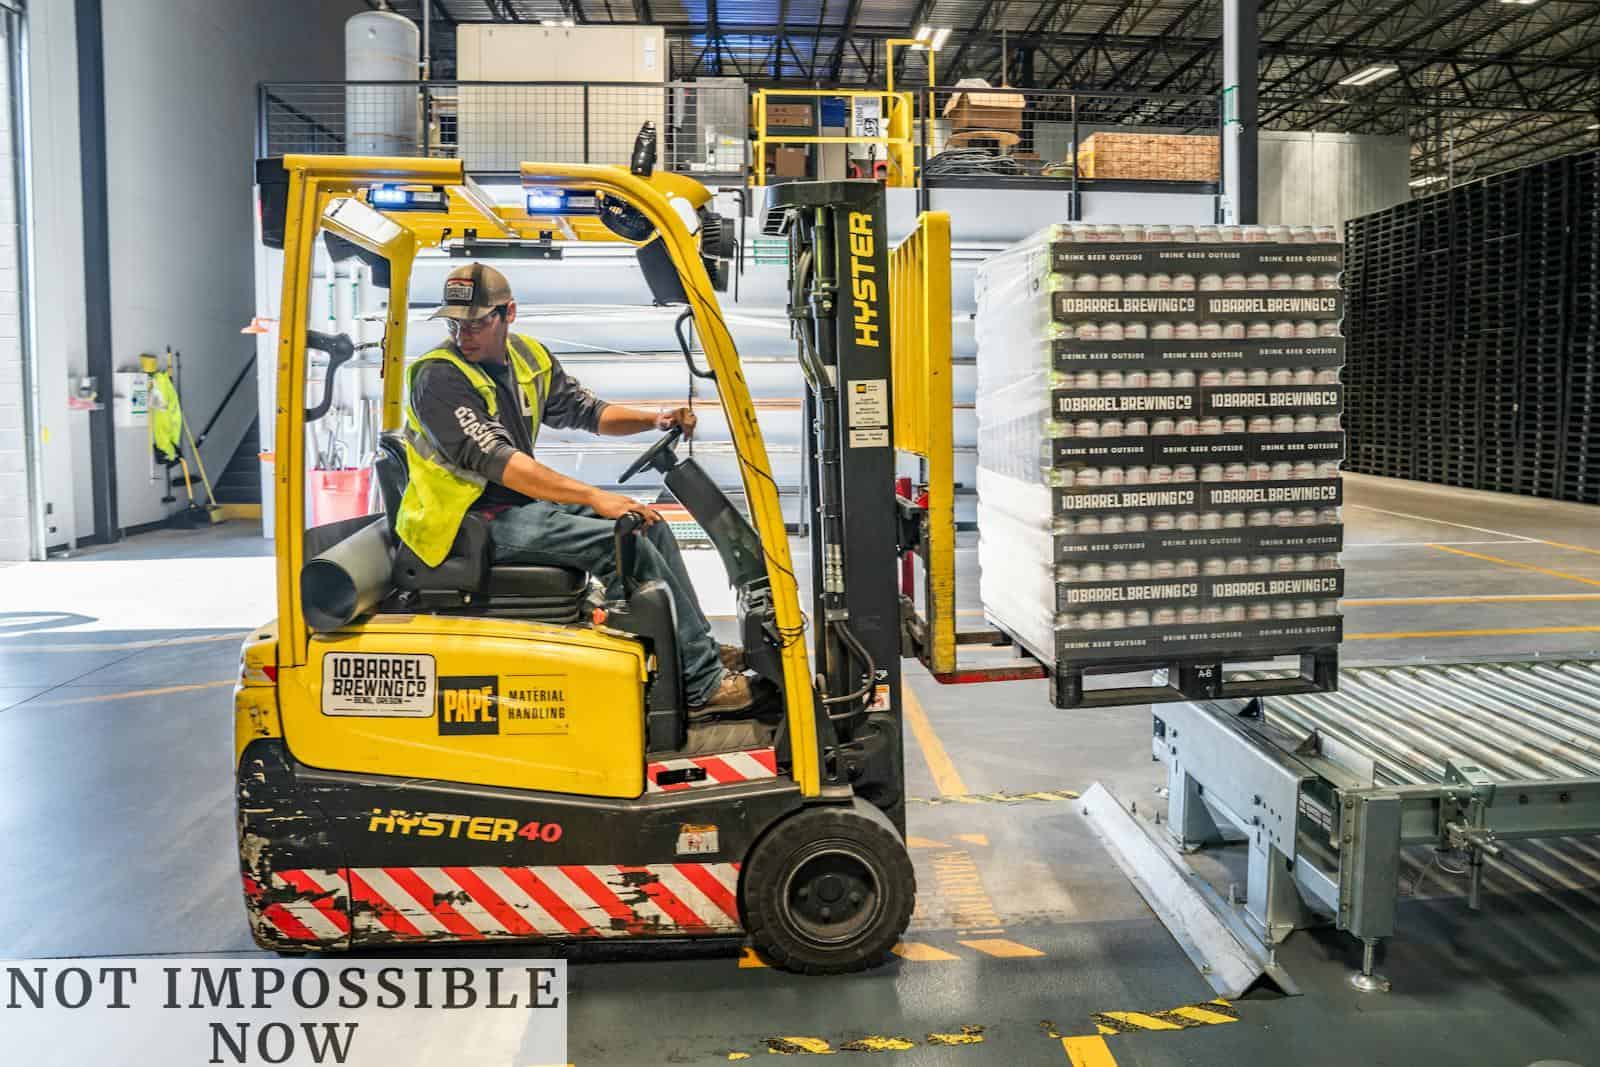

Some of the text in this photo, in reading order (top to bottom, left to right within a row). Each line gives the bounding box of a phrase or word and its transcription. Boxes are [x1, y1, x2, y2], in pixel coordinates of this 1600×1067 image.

[849, 211, 880, 347] HYSTER
[509, 690, 564, 702] MATERIAL
[508, 706, 565, 720] HANDLING
[368, 808, 562, 842] HYSTER 40
